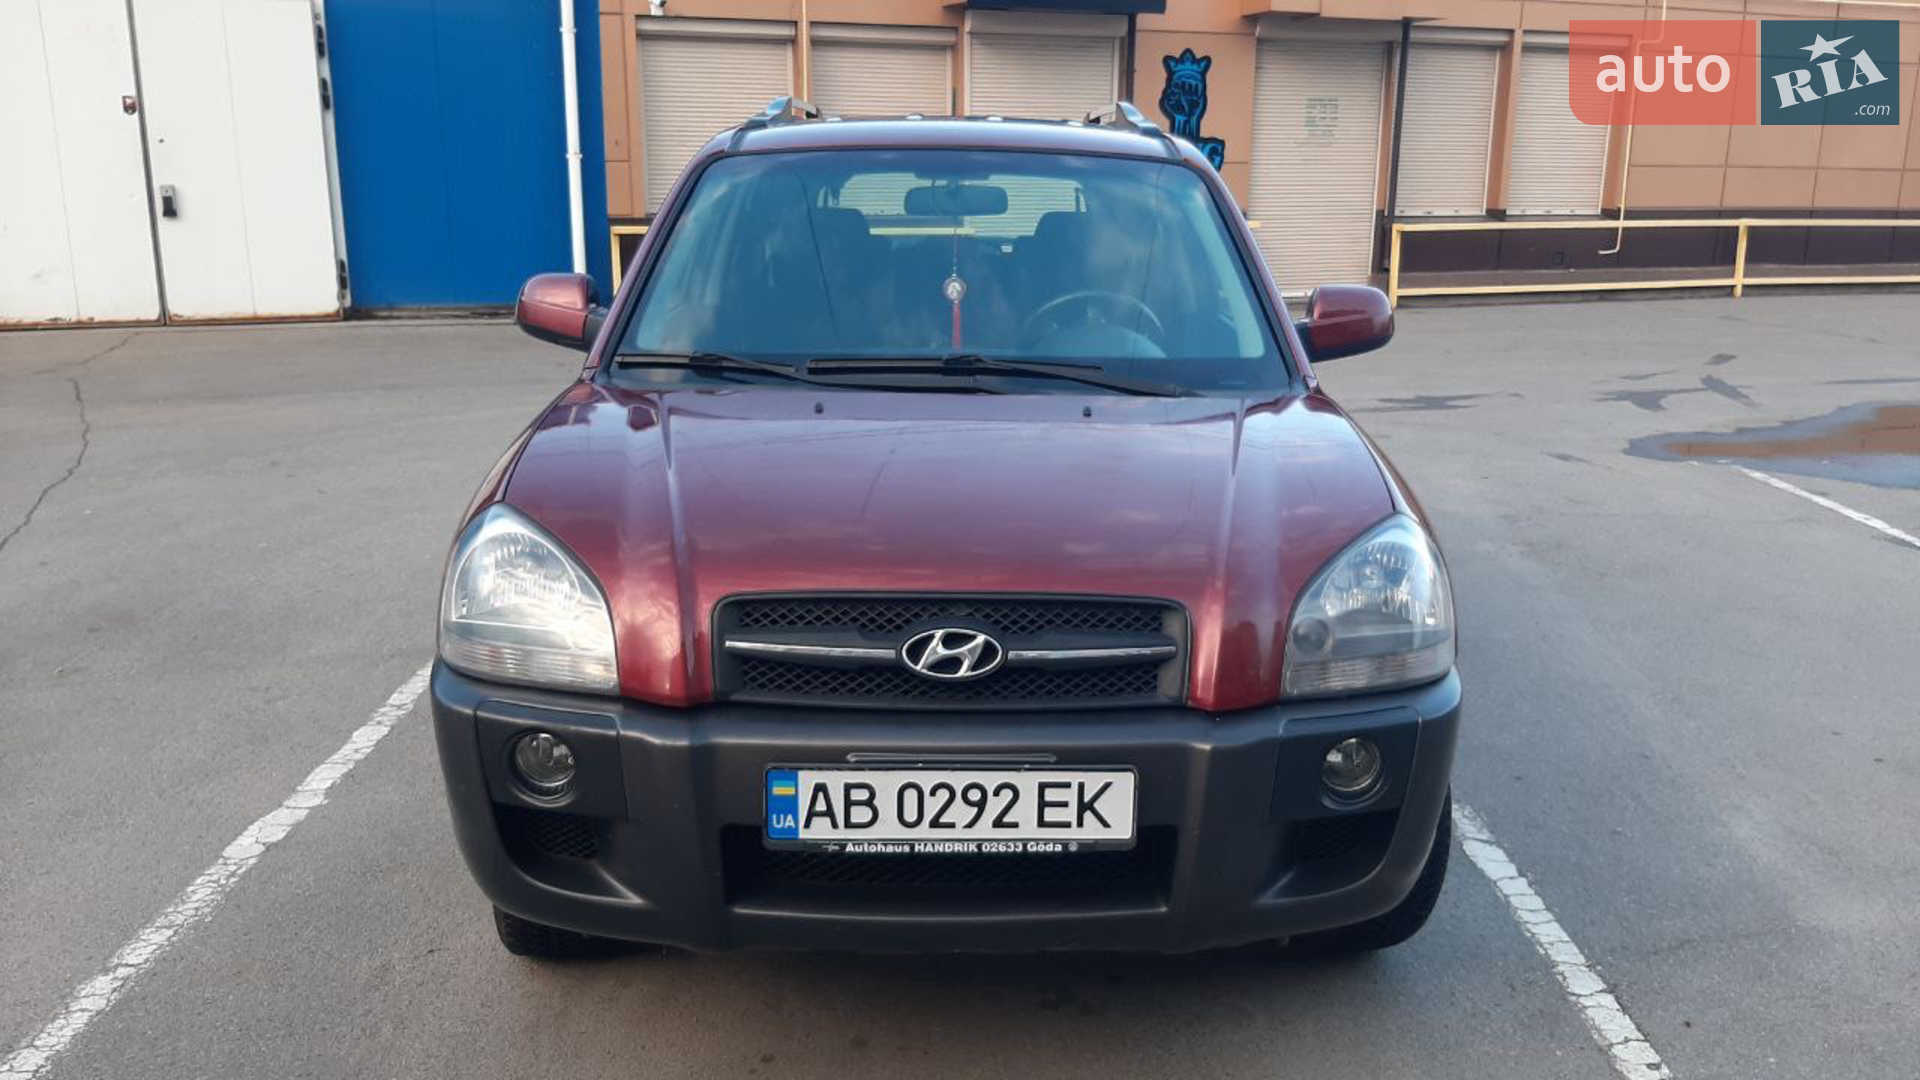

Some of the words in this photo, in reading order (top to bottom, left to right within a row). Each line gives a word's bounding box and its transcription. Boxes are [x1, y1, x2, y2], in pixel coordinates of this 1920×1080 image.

[803, 781, 880, 829] AB
[896, 781, 1020, 829] 0292
[1037, 781, 1114, 829] EK
[772, 813, 796, 829] UA
[845, 842, 910, 853] Autohaus
[914, 842, 978, 853] HANDRIK
[982, 842, 1023, 853] 02633
